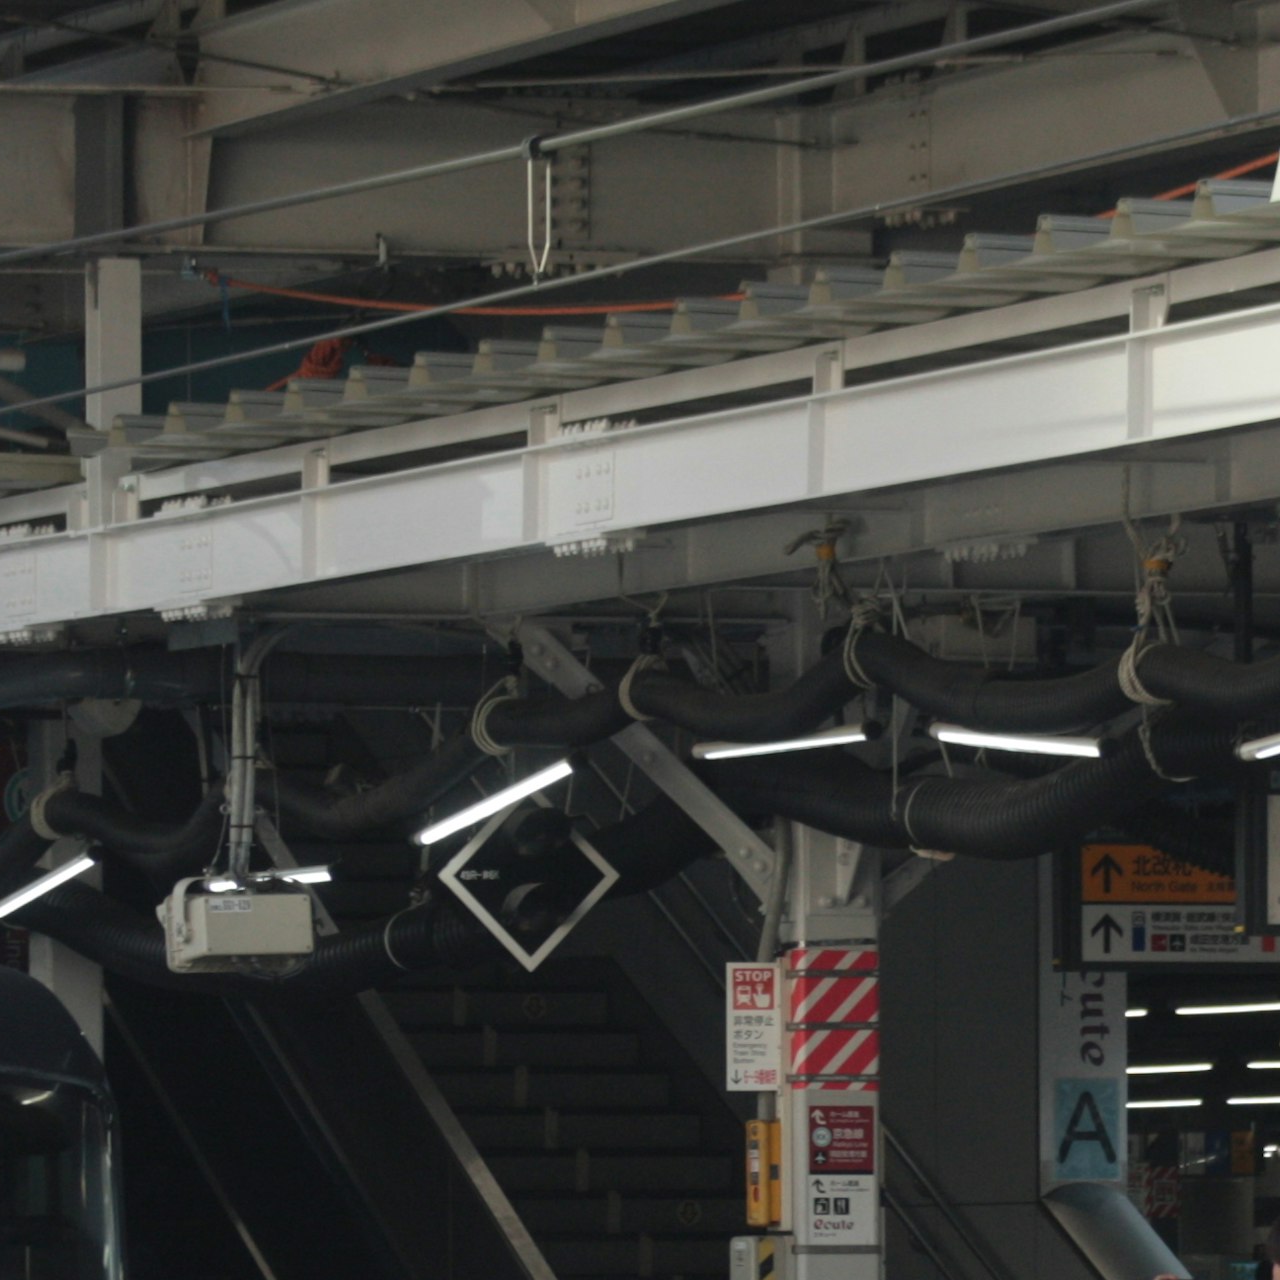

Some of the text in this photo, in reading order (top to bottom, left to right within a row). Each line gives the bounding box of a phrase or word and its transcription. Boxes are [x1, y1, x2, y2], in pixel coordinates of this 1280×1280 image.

[1131, 881, 1165, 893] North
[1168, 880, 1198, 893] Gate
[735, 970, 772, 982] STOP
[733, 1030, 765, 1041] ボタン
[1056, 1091, 1117, 1164] A
[813, 1218, 854, 1231] ecute
